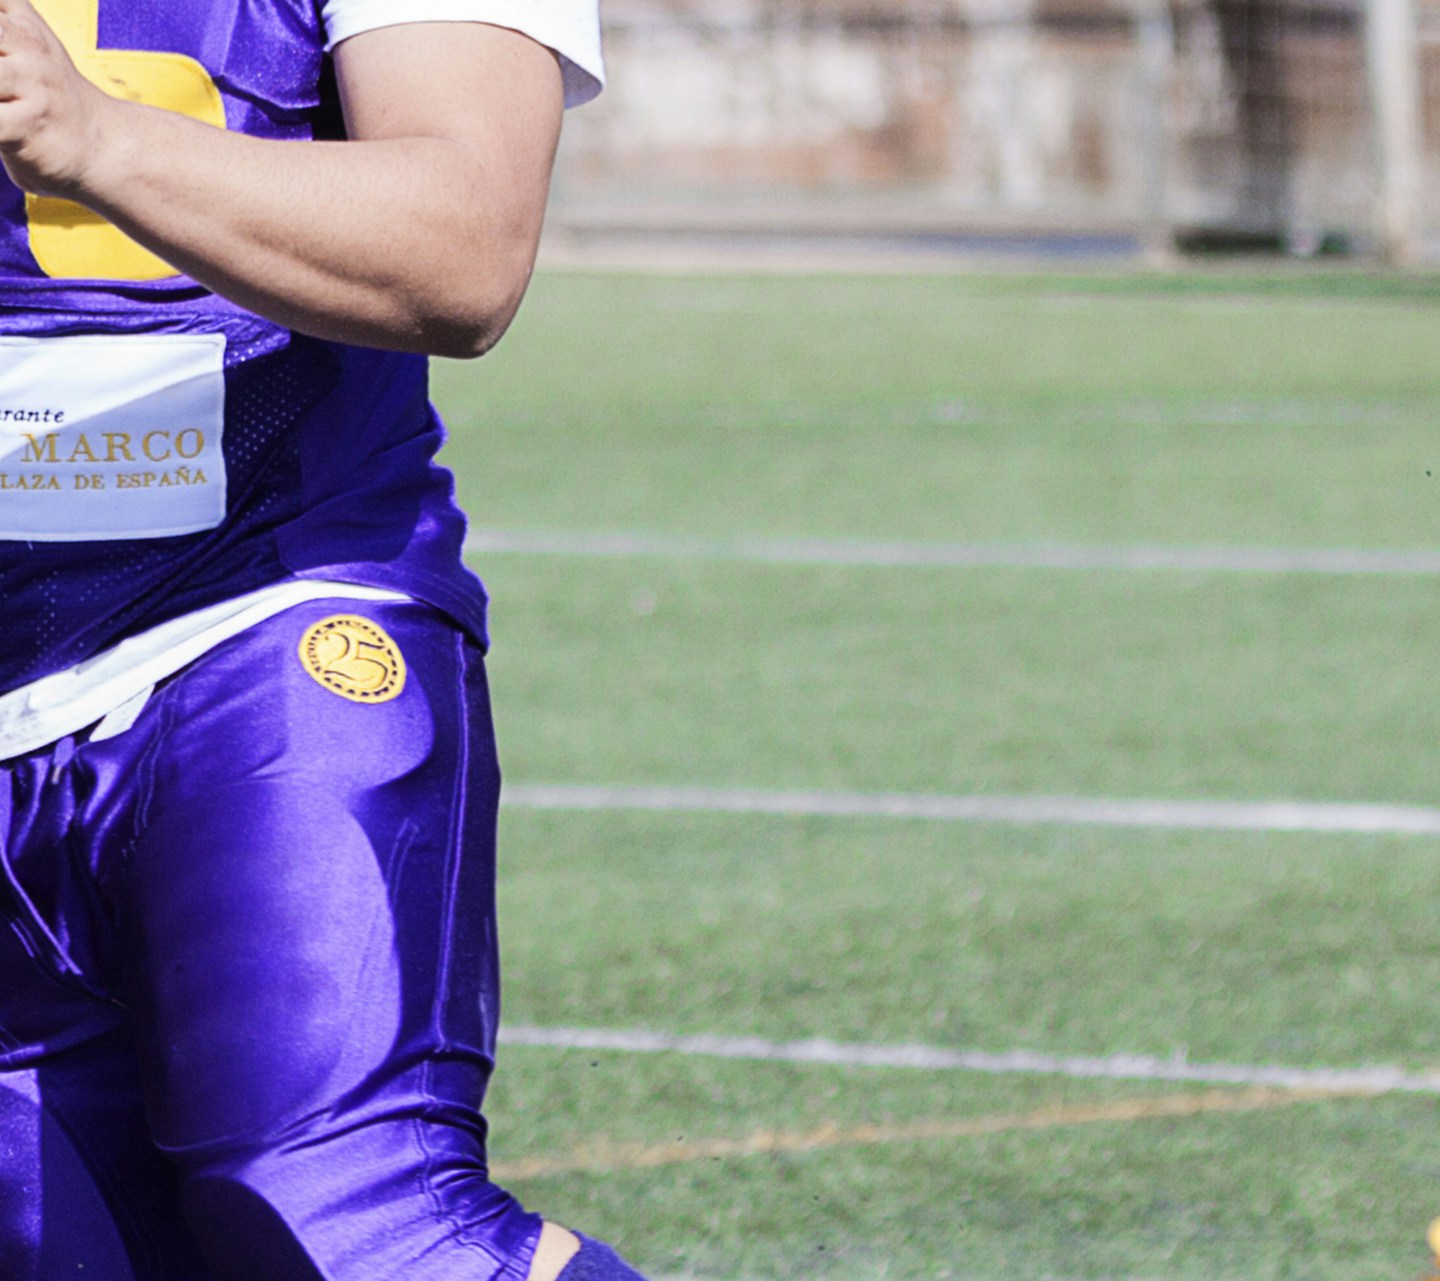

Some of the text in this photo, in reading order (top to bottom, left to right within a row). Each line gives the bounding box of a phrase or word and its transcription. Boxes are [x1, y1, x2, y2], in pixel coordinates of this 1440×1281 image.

[20, 428, 206, 464] MARCO
[74, 473, 106, 491] DE
[116, 465, 209, 490] ESPAÑA
[323, 631, 388, 689] 25
